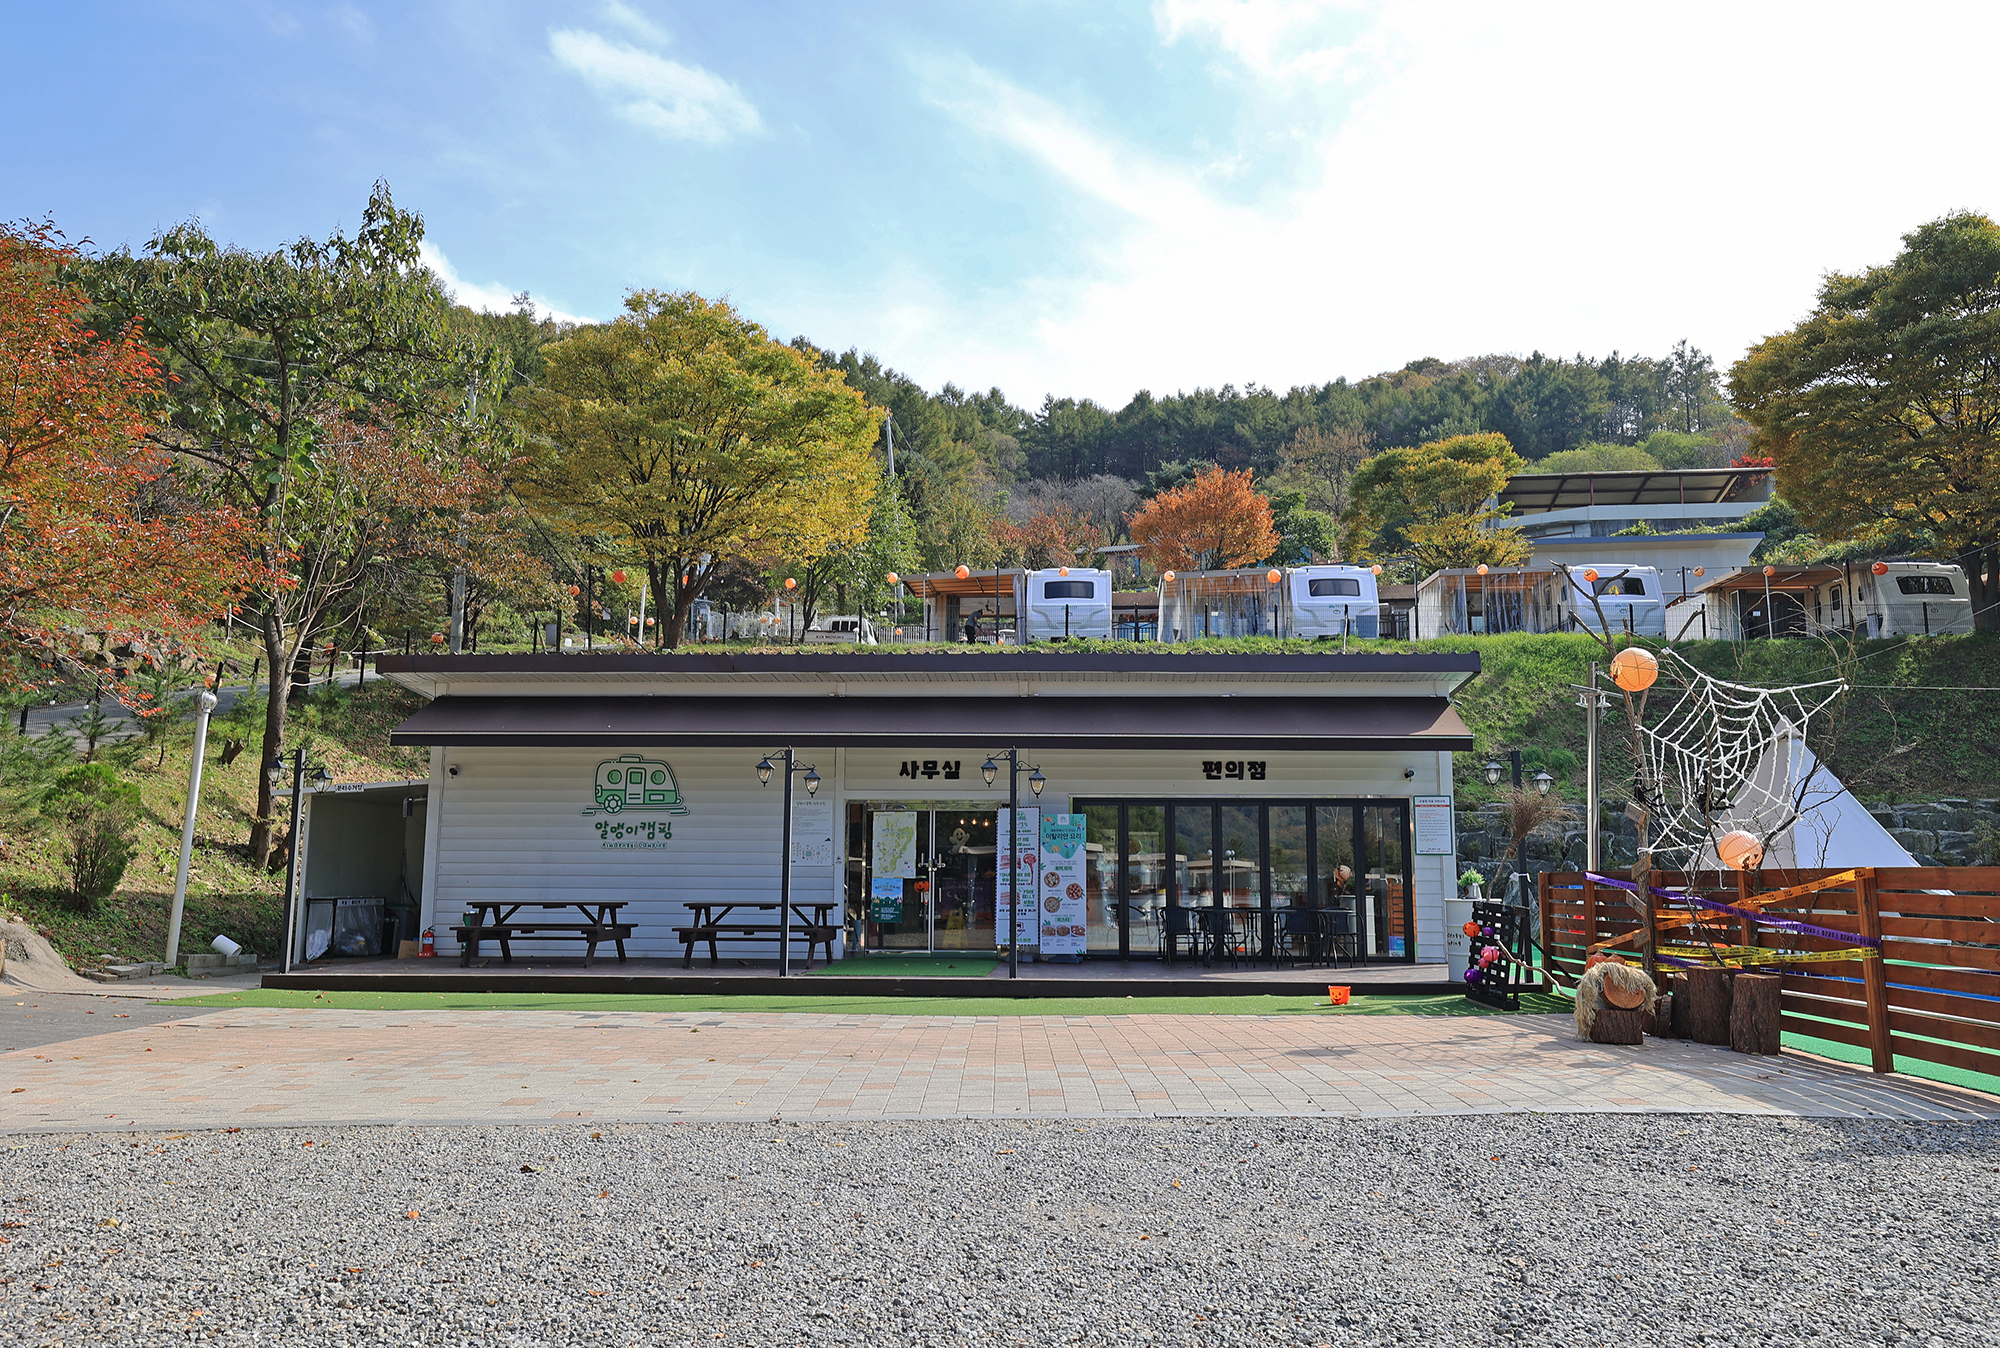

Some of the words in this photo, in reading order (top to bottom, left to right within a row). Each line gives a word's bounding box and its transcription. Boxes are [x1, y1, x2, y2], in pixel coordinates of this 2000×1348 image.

[899, 760, 961, 780] 사무실
[1202, 761, 1267, 780] 편의점
[595, 820, 673, 840] 알맹이캠핑
